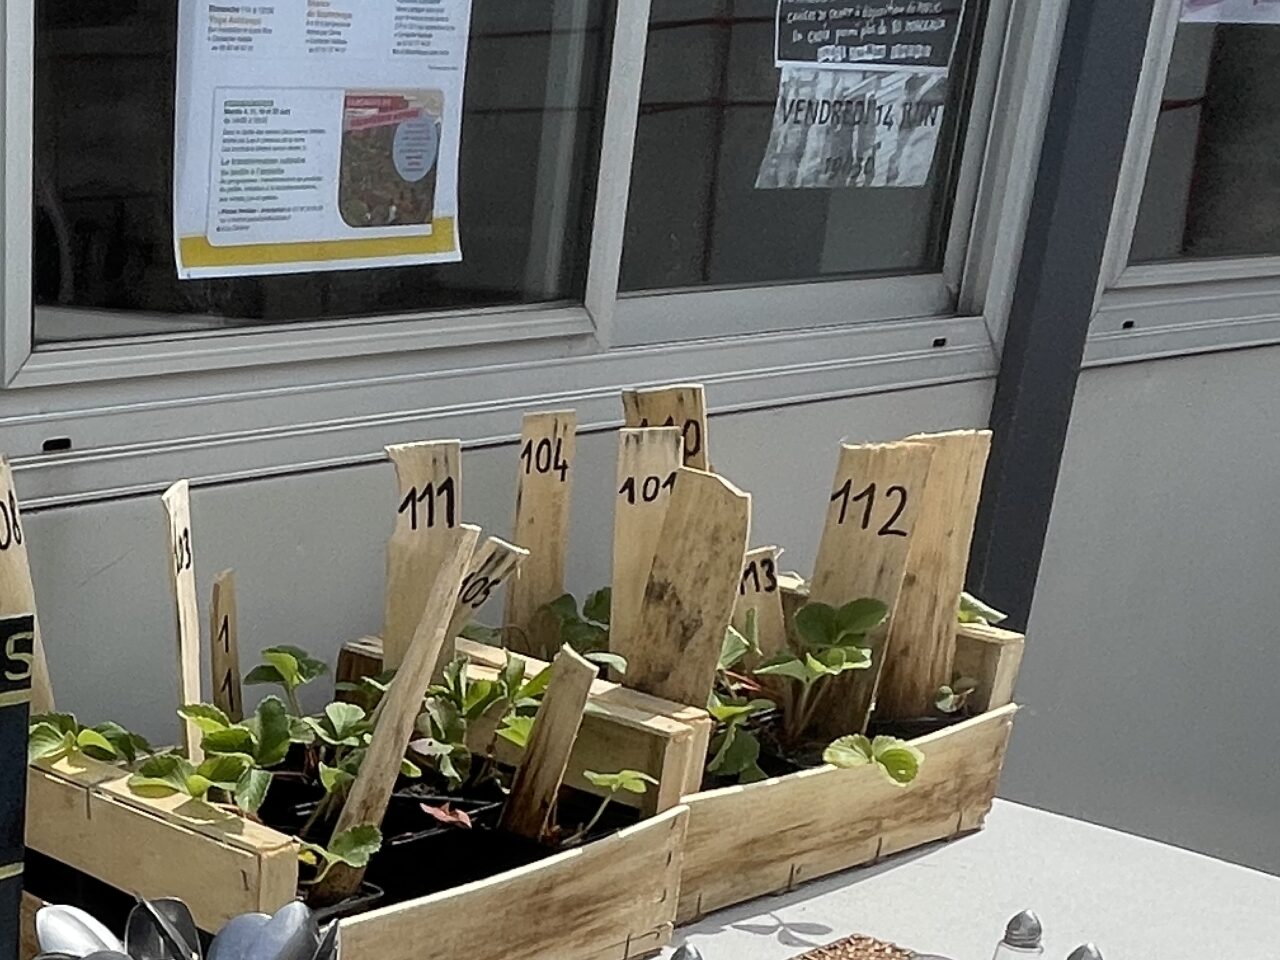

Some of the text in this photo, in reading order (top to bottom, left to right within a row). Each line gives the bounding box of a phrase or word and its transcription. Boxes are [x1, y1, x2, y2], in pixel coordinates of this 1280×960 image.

[876, 103, 894, 131] 14
[519, 438, 569, 483] 104
[397, 475, 456, 531] 111
[618, 471, 678, 505] 101
[830, 477, 908, 538] 112
